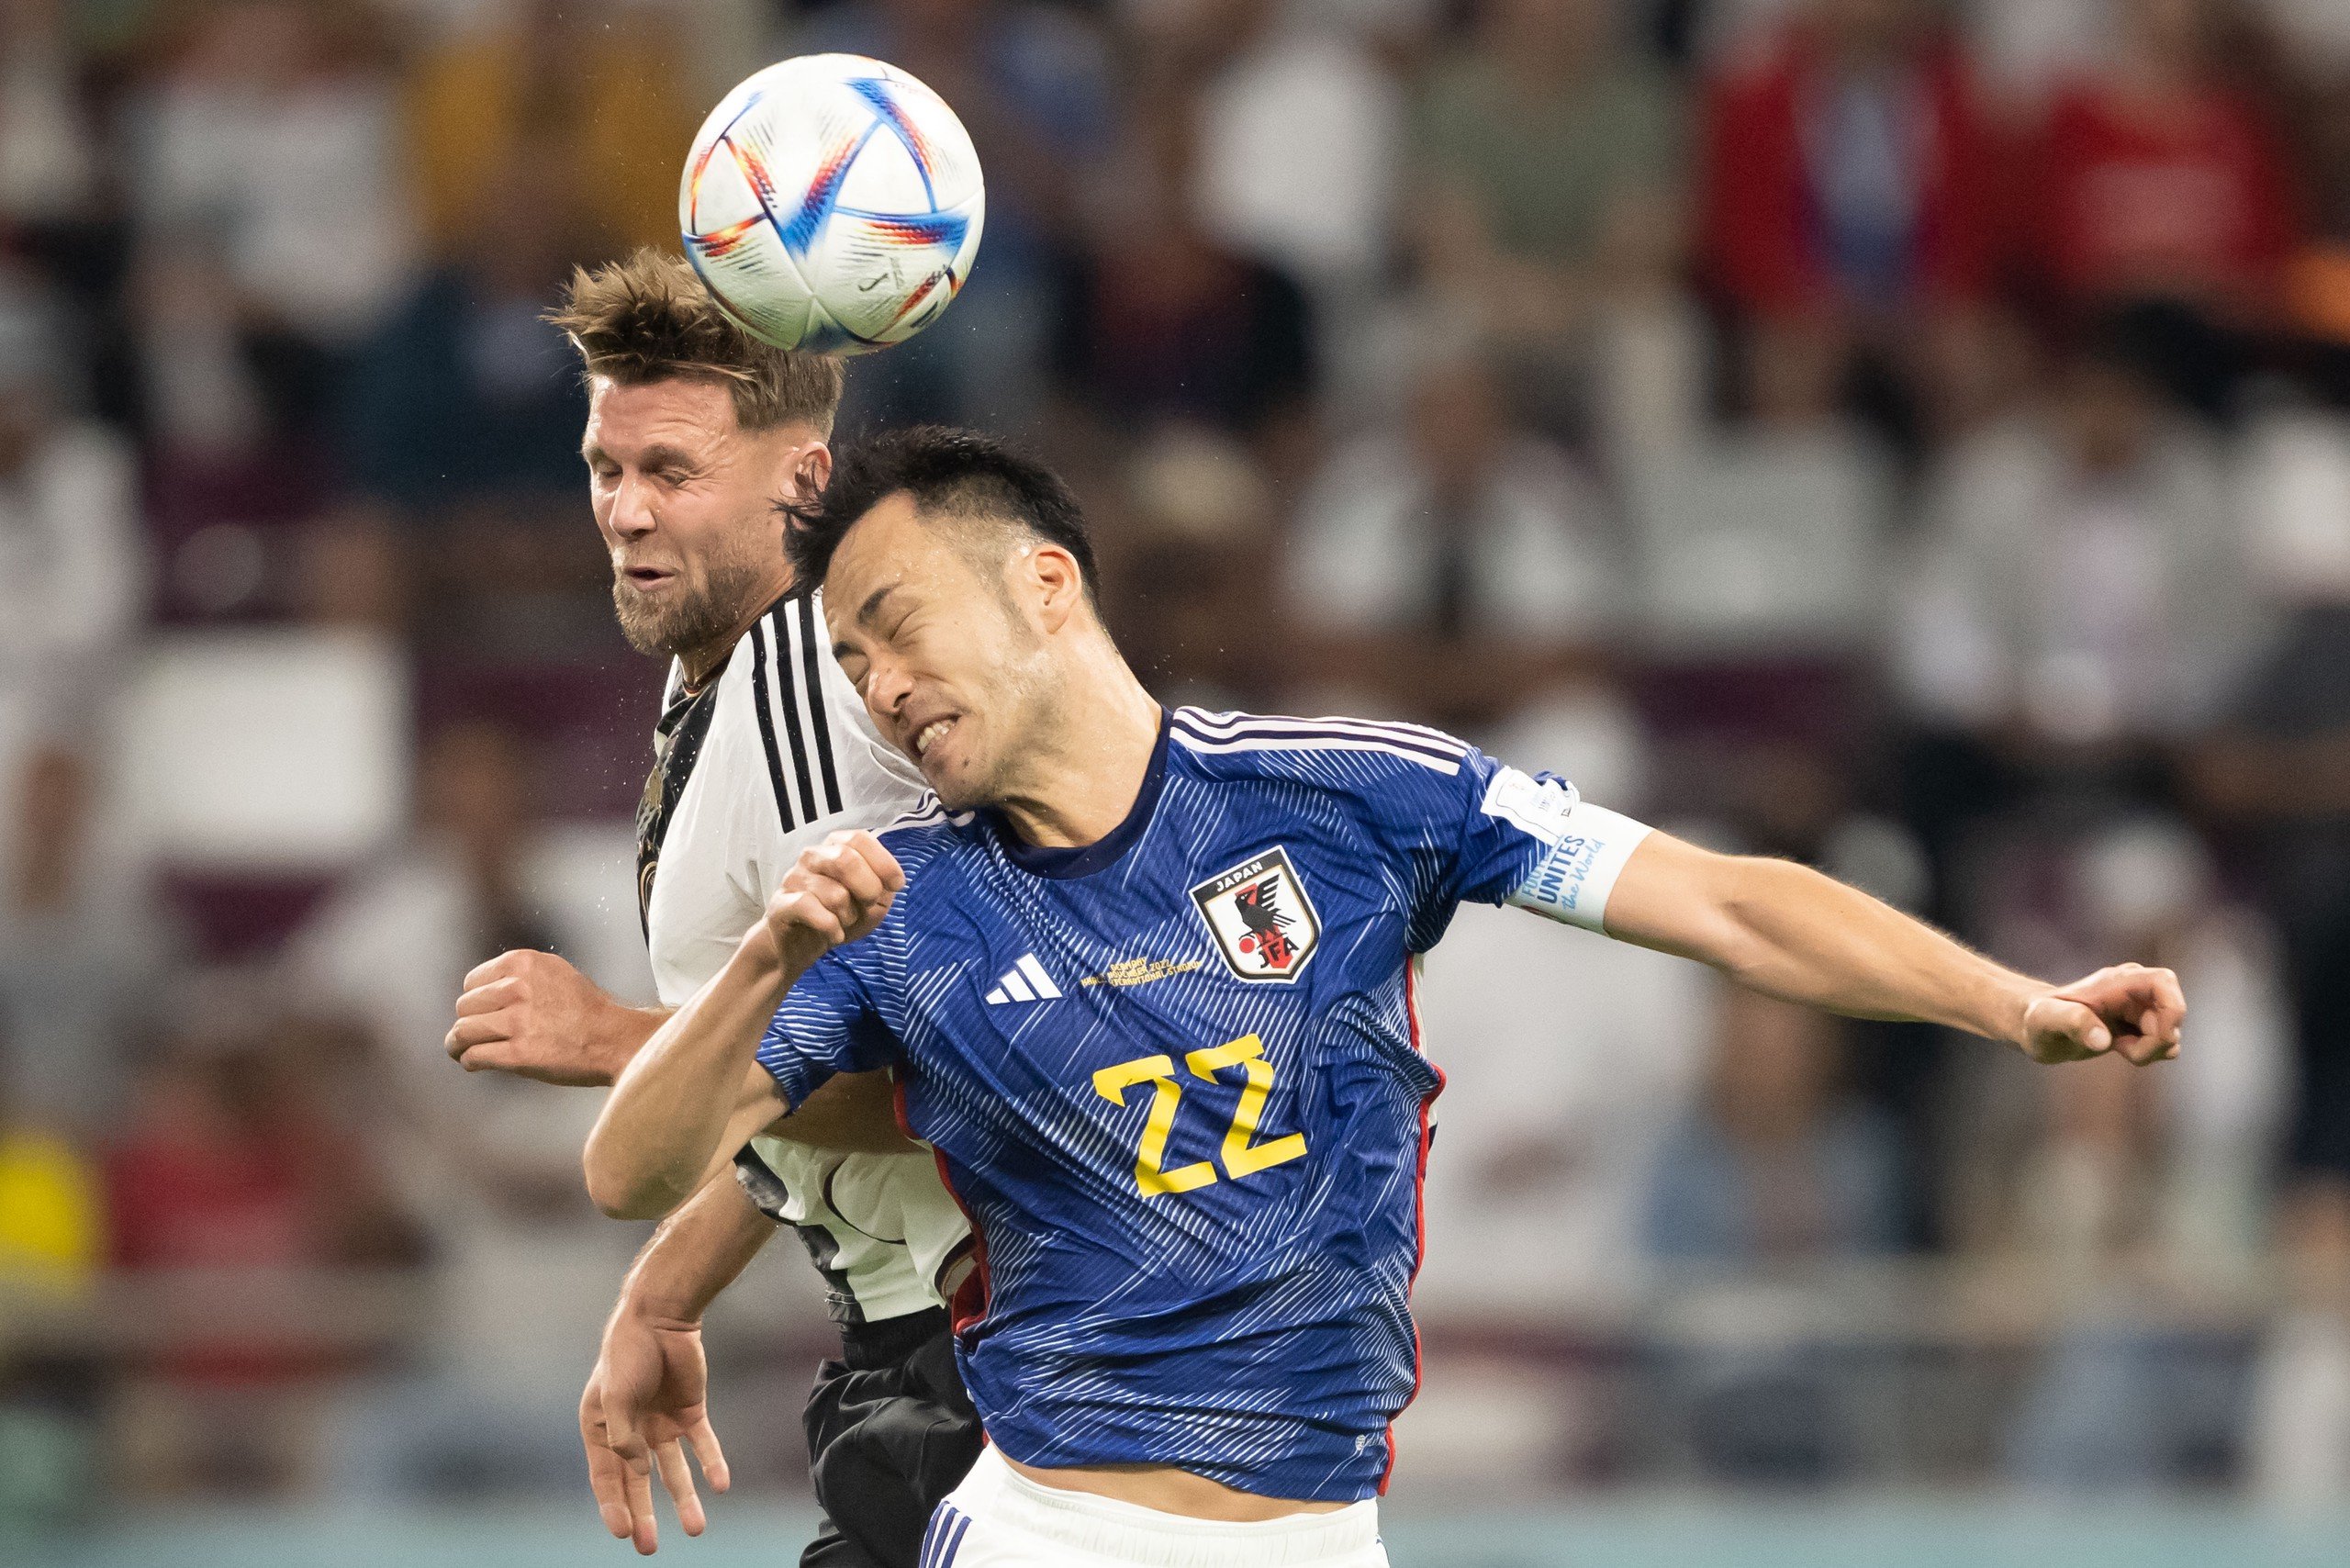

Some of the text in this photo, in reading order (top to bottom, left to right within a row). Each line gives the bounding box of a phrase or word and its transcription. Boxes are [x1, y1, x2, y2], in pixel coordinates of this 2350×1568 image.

[1216, 861, 1263, 892] JAPAN
[1538, 835, 1585, 904] UNITES
[1561, 838, 1606, 911] the World
[1259, 936, 1300, 969] JFA
[1092, 1033, 1308, 1198] 22
